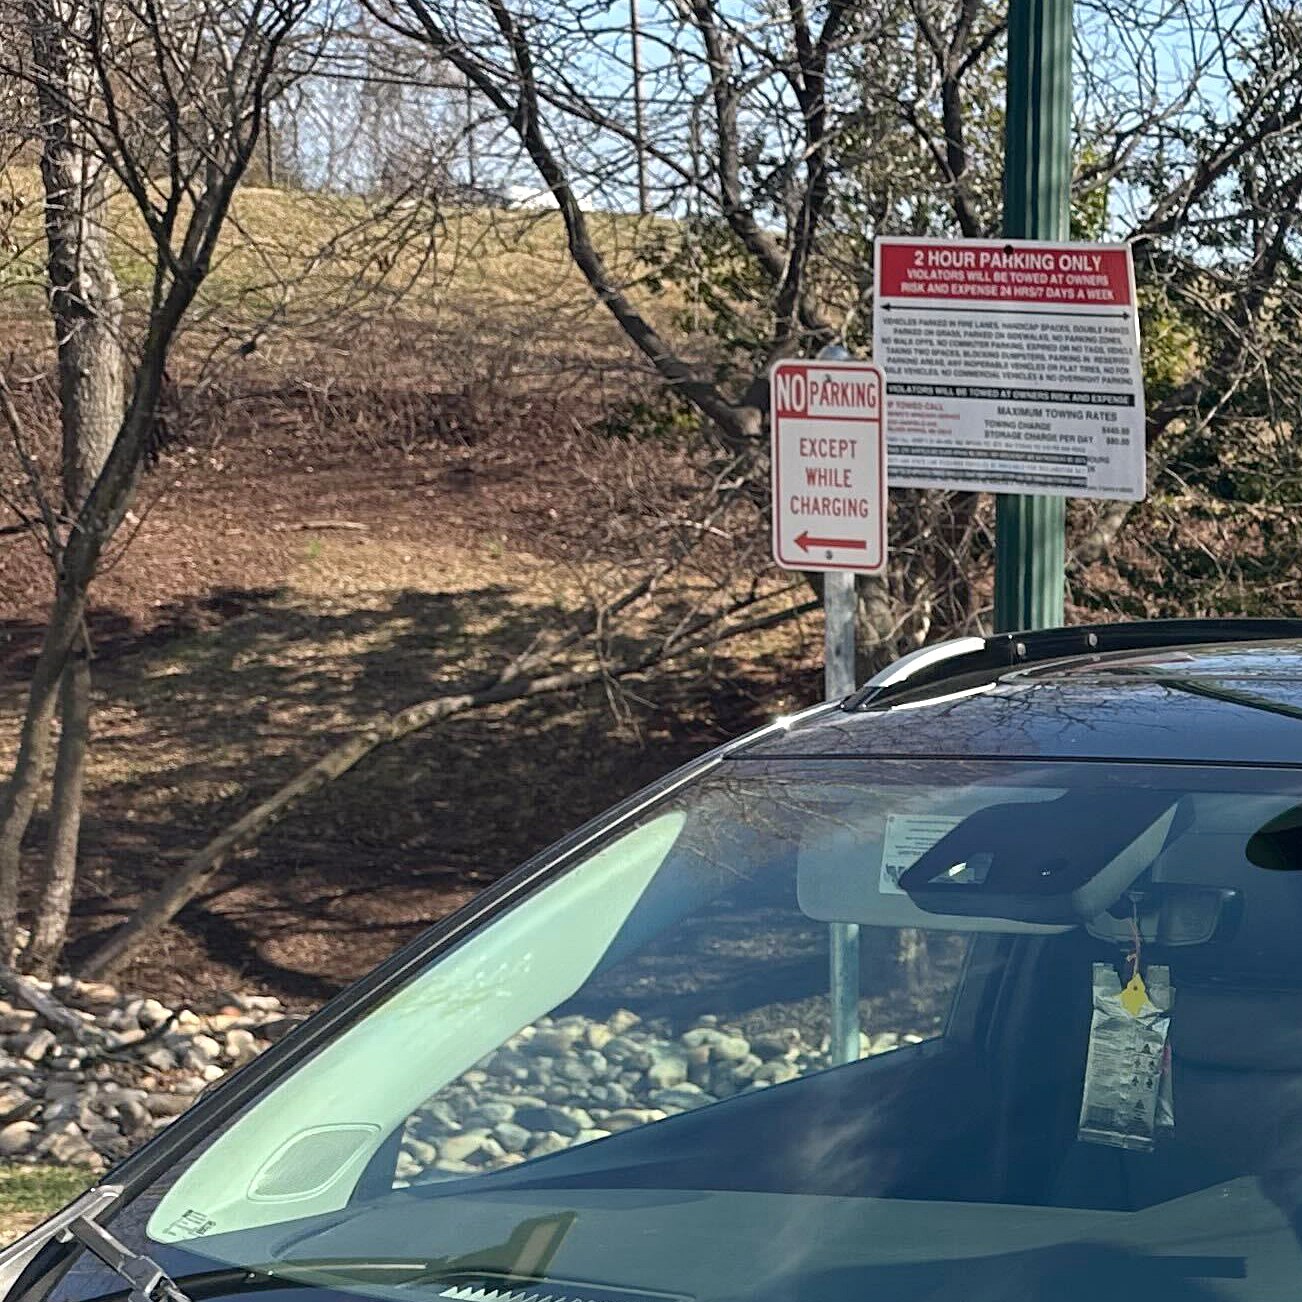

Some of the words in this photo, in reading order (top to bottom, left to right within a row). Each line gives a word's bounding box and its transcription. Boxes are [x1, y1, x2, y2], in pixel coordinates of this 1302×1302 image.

[914, 250, 924, 266] 2
[927, 250, 976, 268] HOUR
[980, 251, 1055, 271] PARKING
[1058, 254, 1102, 272] ONLY
[906, 268, 965, 281] VIOLATORS
[966, 270, 992, 283] WILL
[993, 271, 1009, 283] BE
[1010, 271, 1049, 285] TOWED
[1049, 273, 1065, 285] AT
[900, 282, 926, 294] RISK
[927, 282, 950, 295] AND
[951, 283, 998, 297] EXPENSE
[1000, 285, 1012, 297] 24
[1045, 287, 1076, 299] DAYS
[1077, 288, 1086, 299] A
[1086, 288, 1115, 301] WEEK
[776, 372, 807, 413] NO
[808, 380, 877, 409] PARKING
[997, 406, 1043, 418] MAXIMUM
[1045, 408, 1084, 420] TOWING
[1085, 410, 1118, 422] RATES
[798, 437, 858, 460] EXCEPT
[804, 466, 854, 489] WHILE
[789, 495, 870, 519] CHARGING
